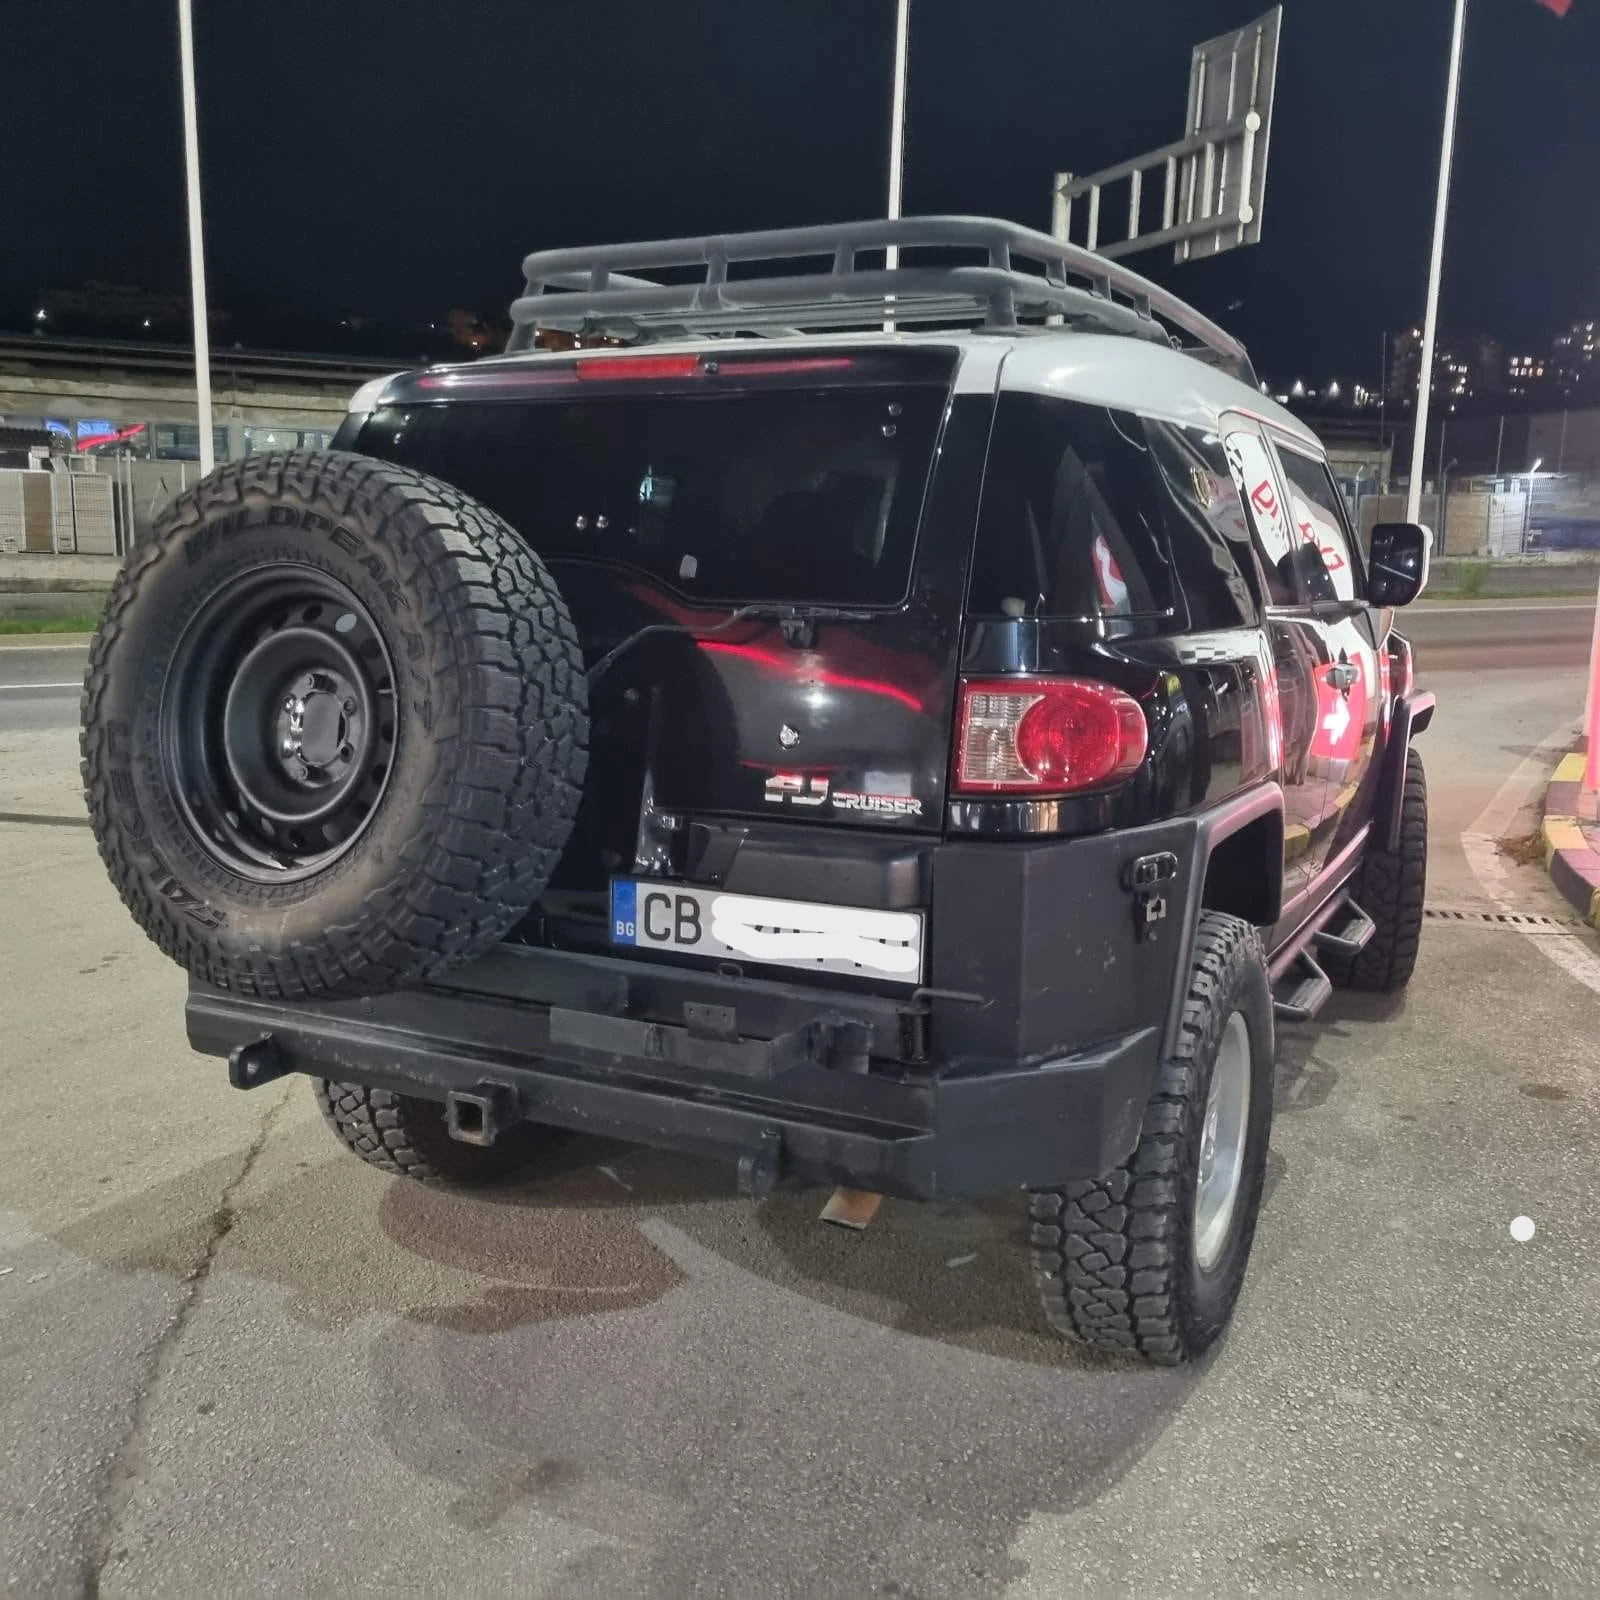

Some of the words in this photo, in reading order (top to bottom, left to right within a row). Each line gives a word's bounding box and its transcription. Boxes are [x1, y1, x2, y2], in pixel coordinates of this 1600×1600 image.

[185, 505, 409, 614] WILDPEAK
[765, 775, 829, 806] FJ
[832, 792, 923, 816] CRUISER
[616, 920, 635, 937] BG
[644, 892, 702, 945] CB
